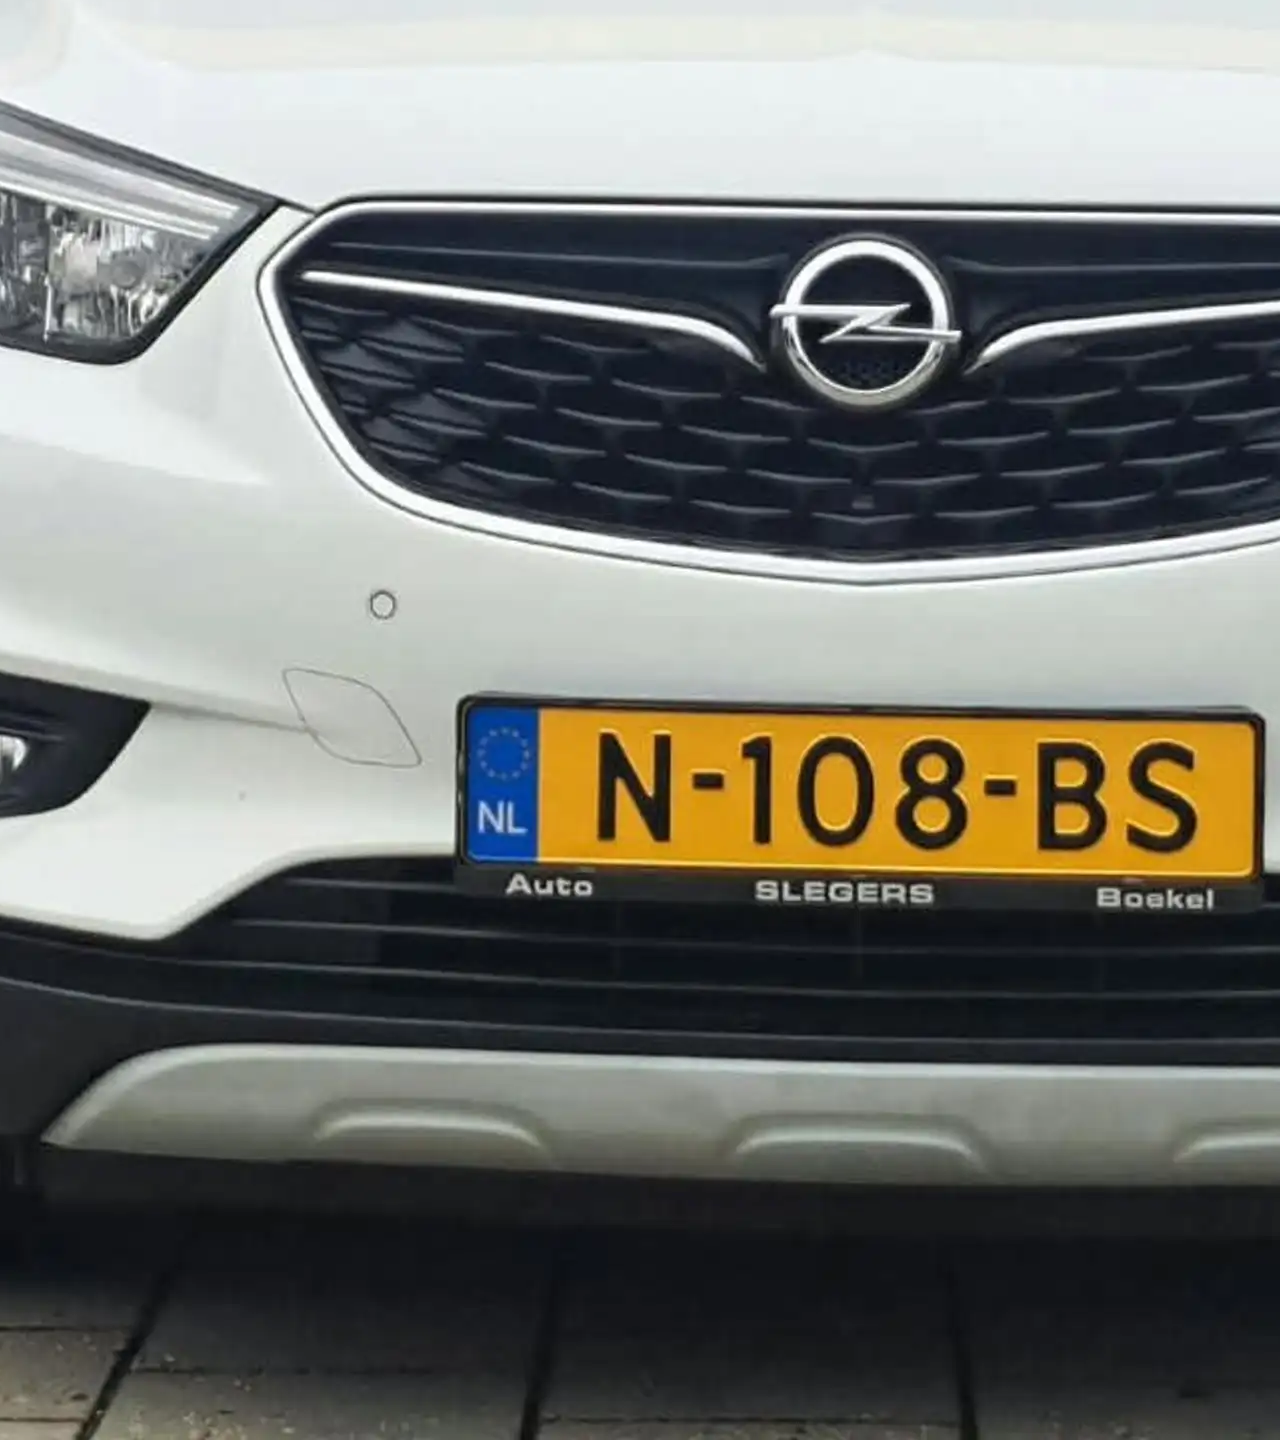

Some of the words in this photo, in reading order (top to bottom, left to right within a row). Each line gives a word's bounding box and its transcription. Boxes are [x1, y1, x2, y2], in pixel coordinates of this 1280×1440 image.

[596, 730, 1199, 853] N-108-BS
[477, 800, 527, 834] NL
[505, 872, 594, 897] Auto
[754, 879, 935, 905] SLEGERS
[1096, 886, 1215, 910] Boekel
